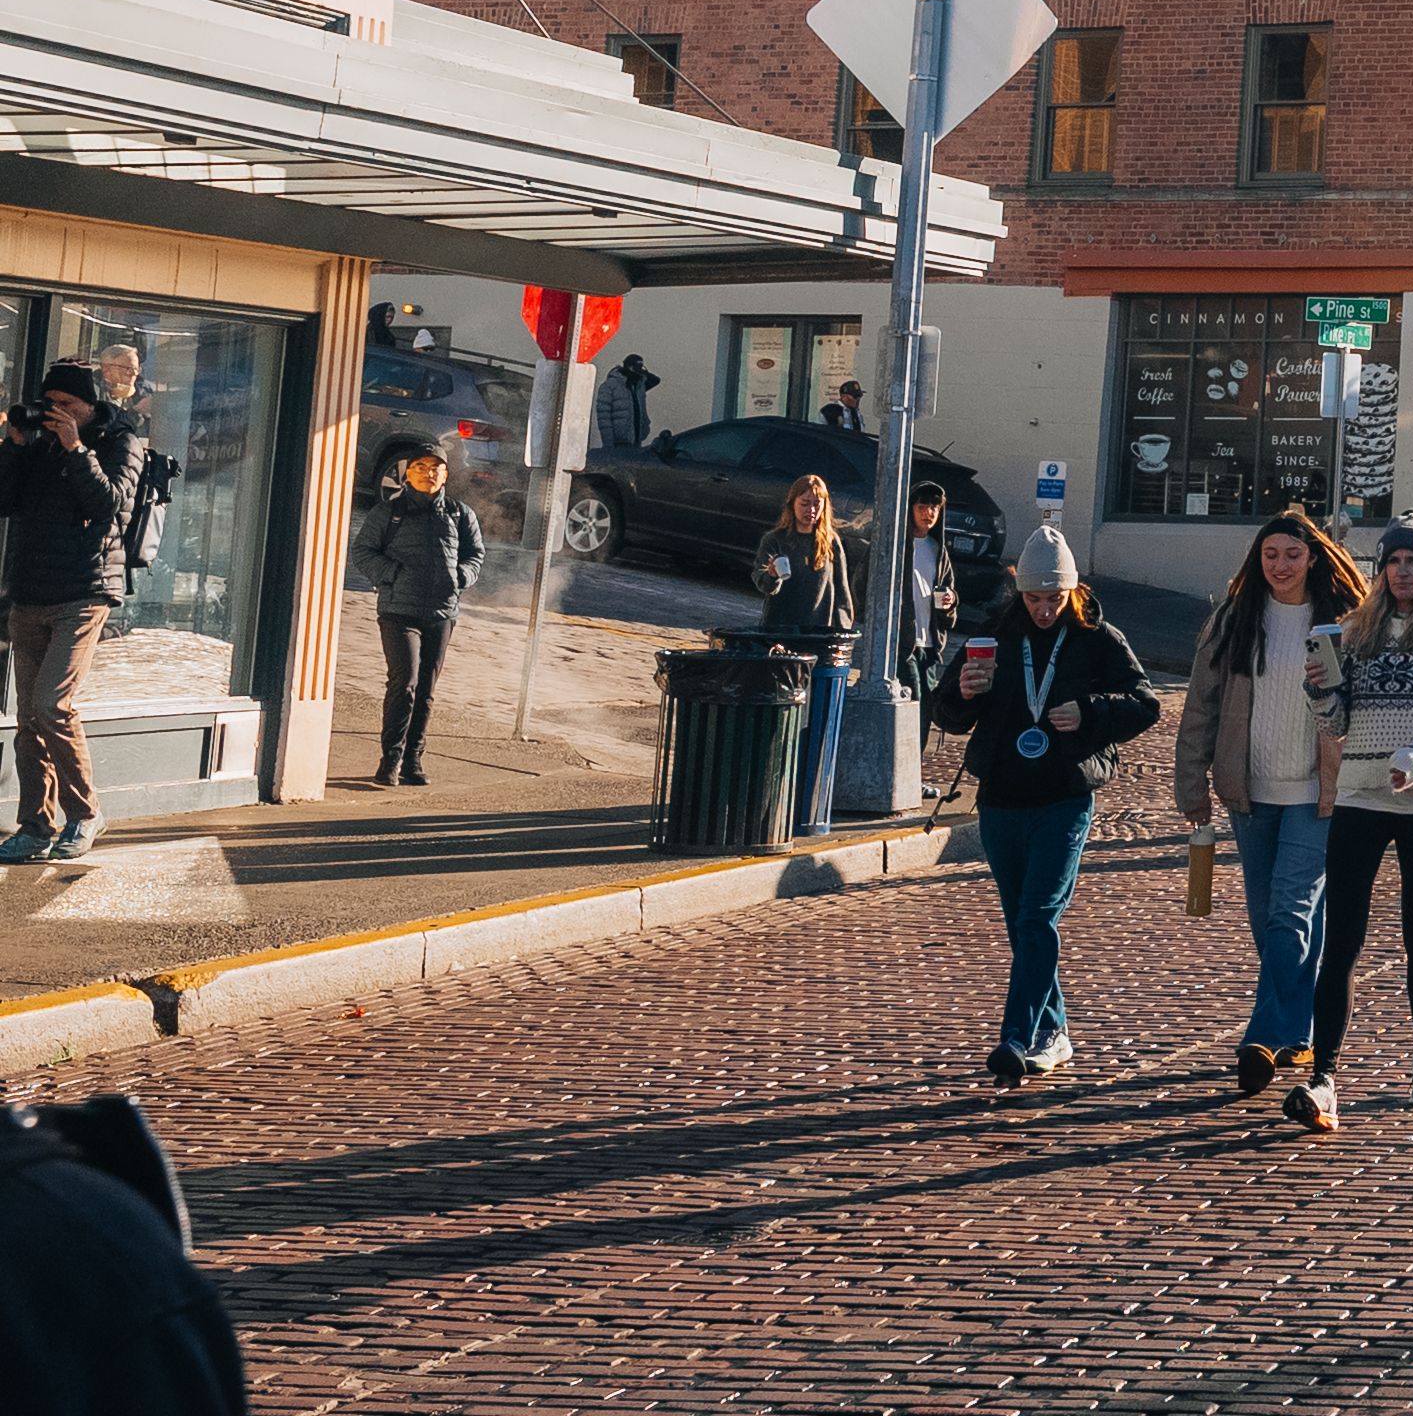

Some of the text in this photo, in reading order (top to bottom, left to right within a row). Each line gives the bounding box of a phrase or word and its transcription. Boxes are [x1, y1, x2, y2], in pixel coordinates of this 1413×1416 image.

[1326, 300, 1355, 318] Pine
[1149, 312, 1284, 324] CINNAMON
[1323, 324, 1344, 343] Pike
[1140, 367, 1173, 381] Fresh
[1137, 387, 1175, 405] Coffee
[1272, 435, 1323, 446] BAKERY
[1211, 442, 1236, 457] Tea
[1276, 455, 1315, 466] SINCE
[1280, 476, 1309, 487] 1985
